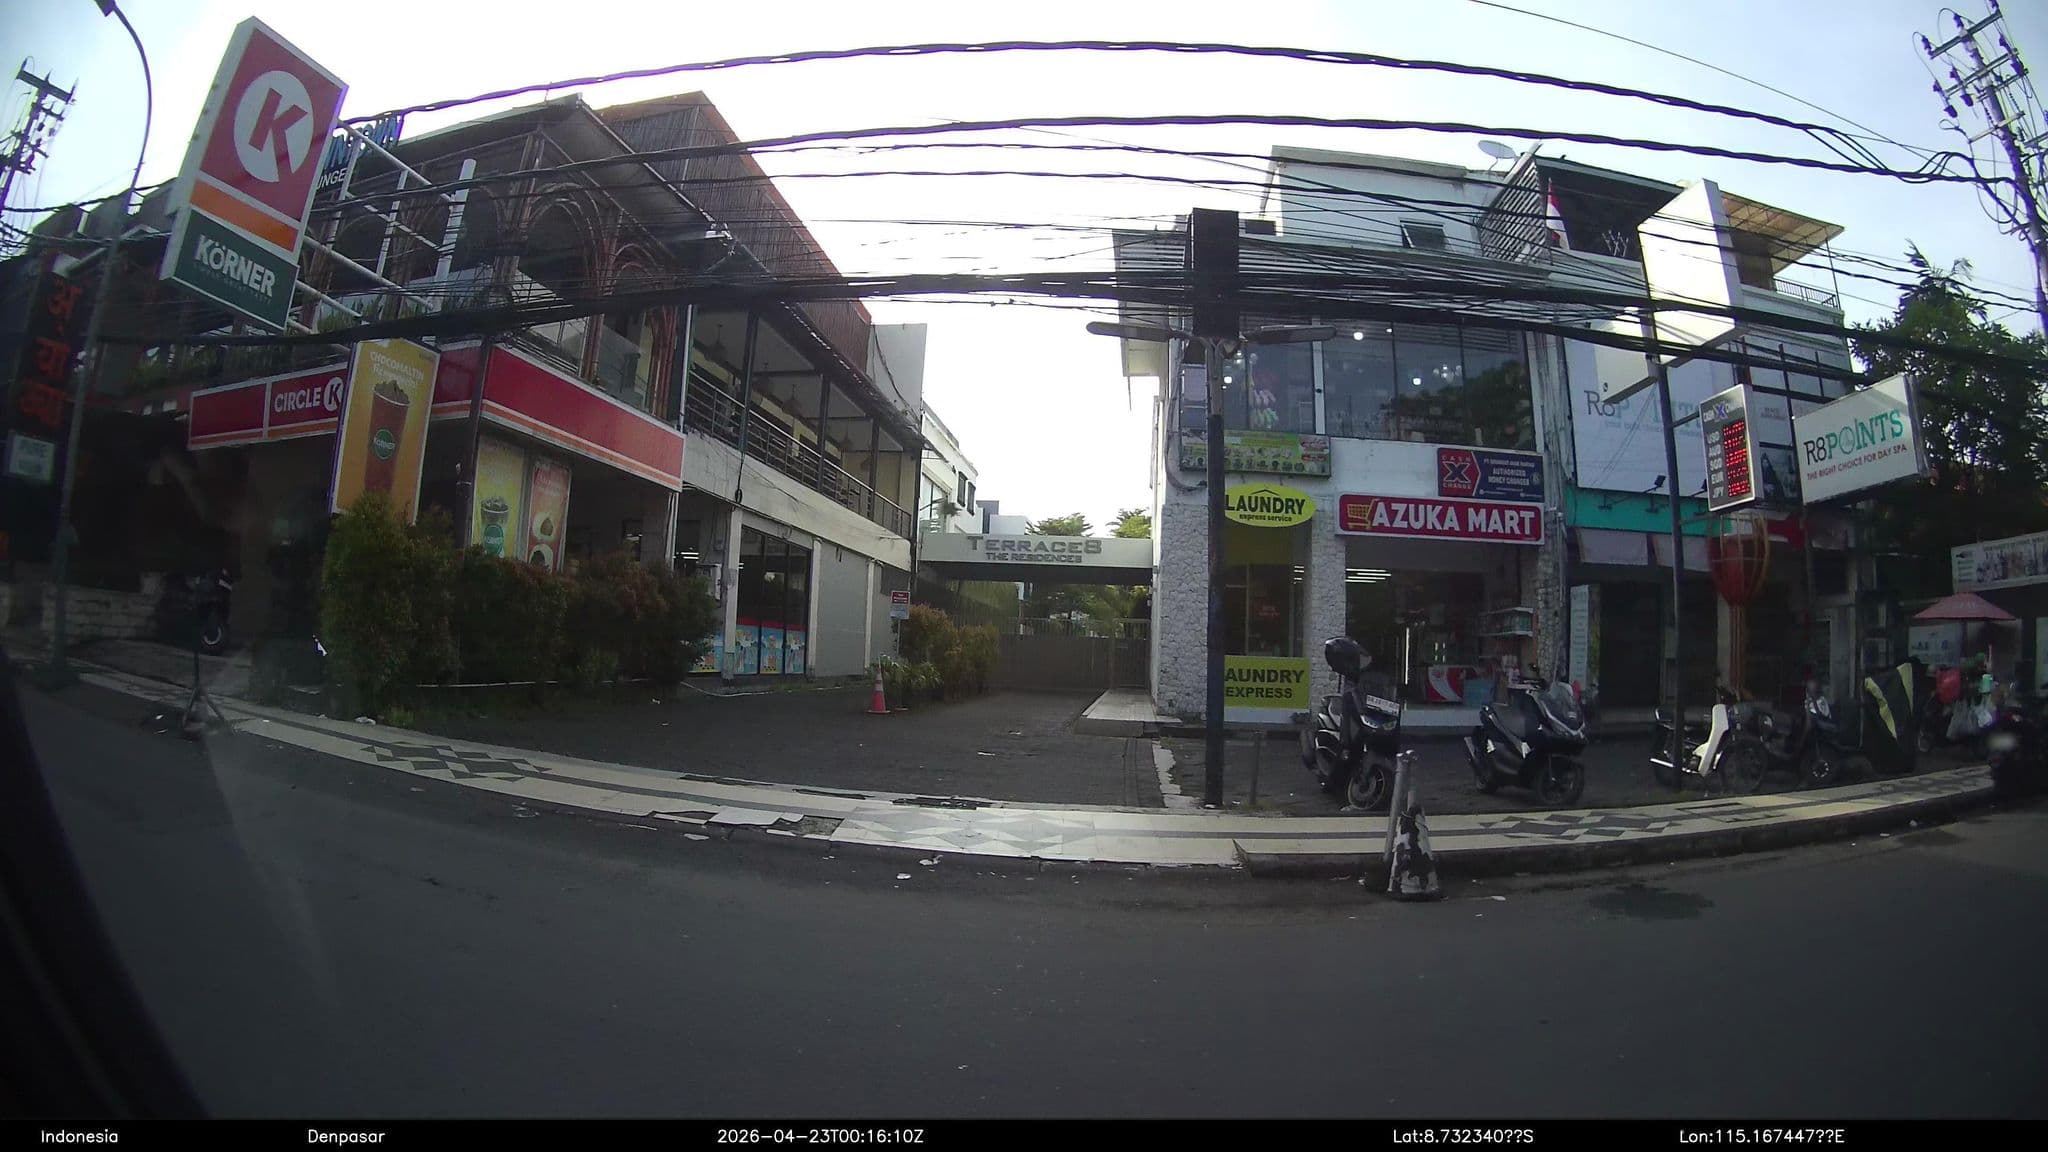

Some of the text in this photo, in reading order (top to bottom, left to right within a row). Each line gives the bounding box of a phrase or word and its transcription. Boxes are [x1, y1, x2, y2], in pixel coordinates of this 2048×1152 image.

[248, 87, 308, 182] K
[195, 234, 276, 298] KÖRNER
[274, 383, 342, 413] CIRCLE K
[1807, 443, 1908, 480] THE RIGHT CHOICE FOR DAY SPA
[1225, 494, 1306, 515] LAUNDRY
[1239, 513, 1292, 522] express service
[1372, 501, 1536, 535] AZUKA MART
[986, 552, 1083, 564] THE RESIDENCES
[1224, 668, 1305, 684] AUNDRY
[1225, 686, 1293, 699] EXPRESS
